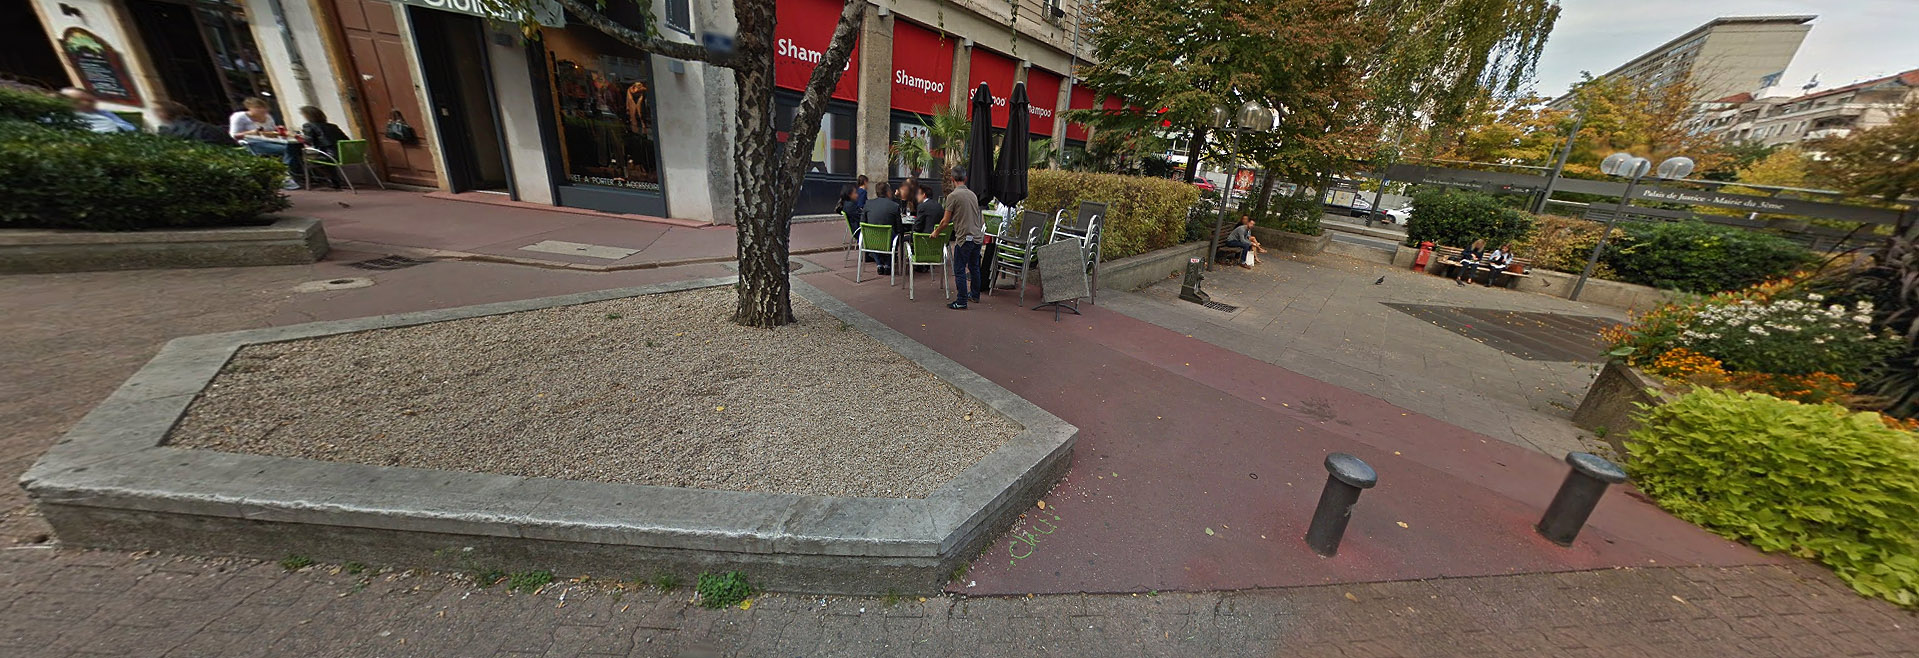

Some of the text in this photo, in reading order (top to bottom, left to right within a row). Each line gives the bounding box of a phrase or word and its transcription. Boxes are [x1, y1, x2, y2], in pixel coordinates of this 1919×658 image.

[896, 69, 944, 94] Shampoo
[1028, 103, 1052, 118] hampoo
[592, 176, 615, 186] PORTER
[625, 180, 660, 191] ACCESSOIR
[1643, 189, 1665, 199] Palais
[1666, 191, 1676, 200] de
[1677, 192, 1705, 202] Justice
[1713, 196, 1742, 206] Mairie
[1743, 199, 1756, 208] du
